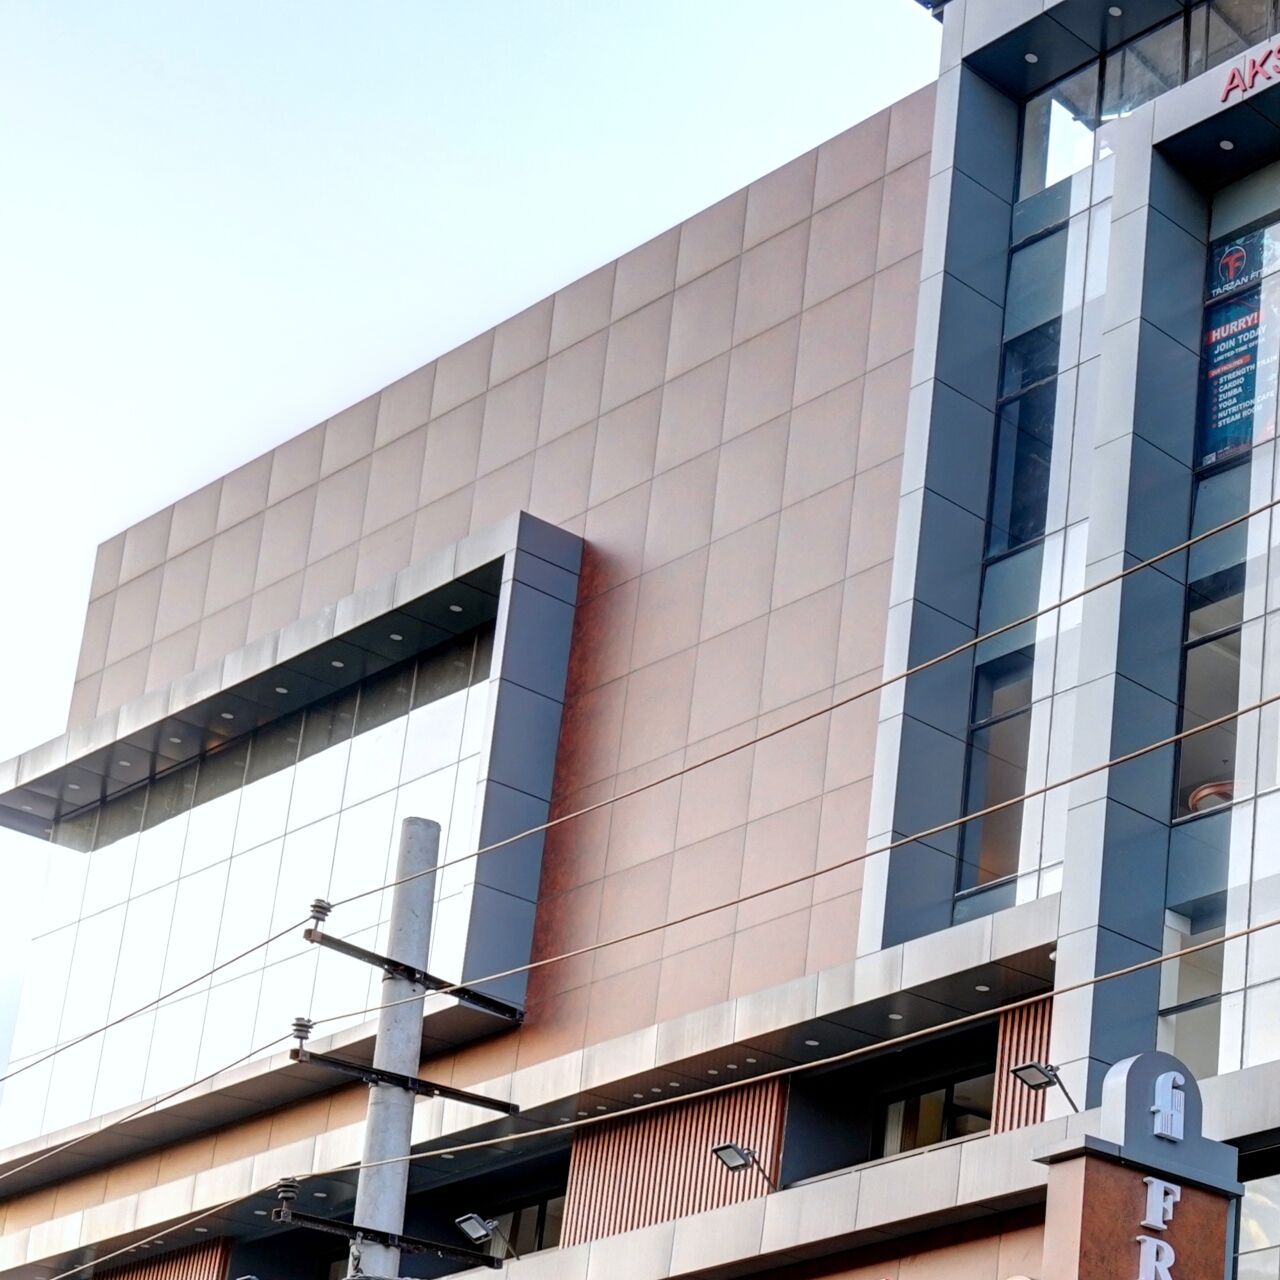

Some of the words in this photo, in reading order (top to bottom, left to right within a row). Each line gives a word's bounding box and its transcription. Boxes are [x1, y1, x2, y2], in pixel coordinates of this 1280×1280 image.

[1212, 311, 1259, 342] HURRY!
[1213, 338, 1236, 355] JOIN
[1238, 324, 1268, 344] TODAY
[1218, 376, 1245, 393] CARDIO
[1218, 387, 1243, 402] ZUMBA
[1218, 397, 1238, 411] YOGA
